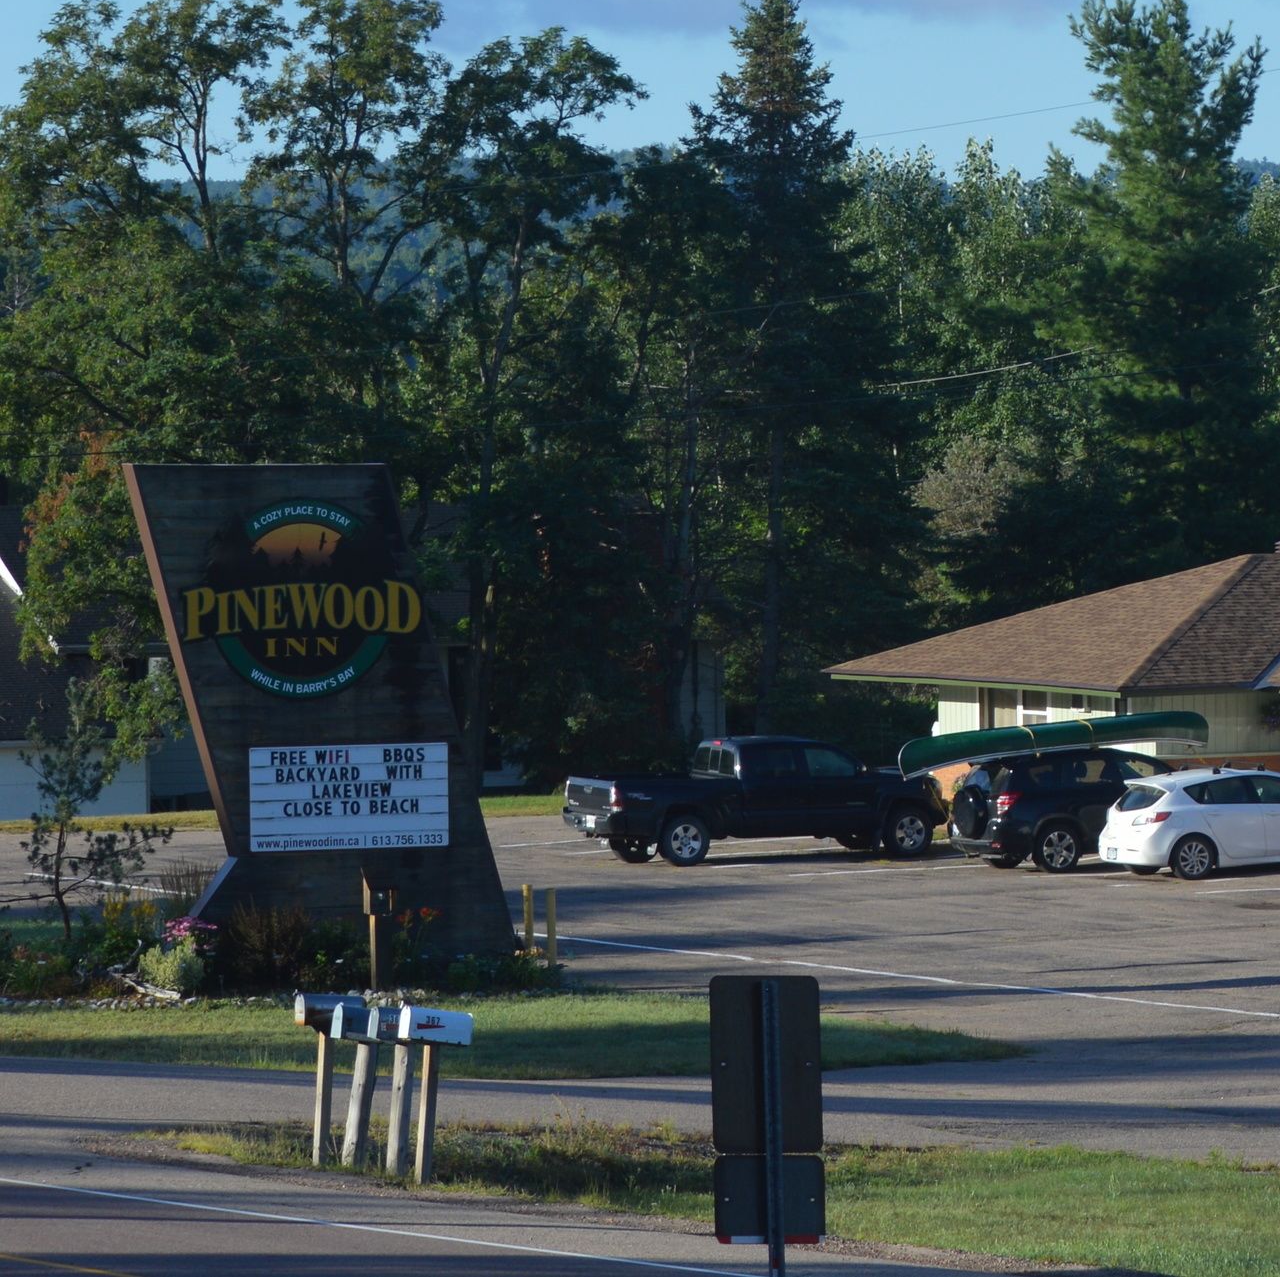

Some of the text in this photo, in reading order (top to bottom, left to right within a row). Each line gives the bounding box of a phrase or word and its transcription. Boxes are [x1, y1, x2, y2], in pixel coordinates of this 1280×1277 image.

[253, 506, 351, 530] A COZY PLACE TO STAY
[182, 579, 422, 642] PINEWOOD
[265, 636, 339, 658] INN
[250, 666, 355, 694] WHILE IN BARRY'S BAY
[270, 747, 426, 766] FREE WIFI BBQS
[275, 764, 423, 783] BACKYARD WITH
[312, 782, 392, 799] LAKEVIEW
[283, 798, 419, 817] CLOSE TO BEACH
[256, 833, 443, 851] www.pinewoodinn.ca 613.756.1333
